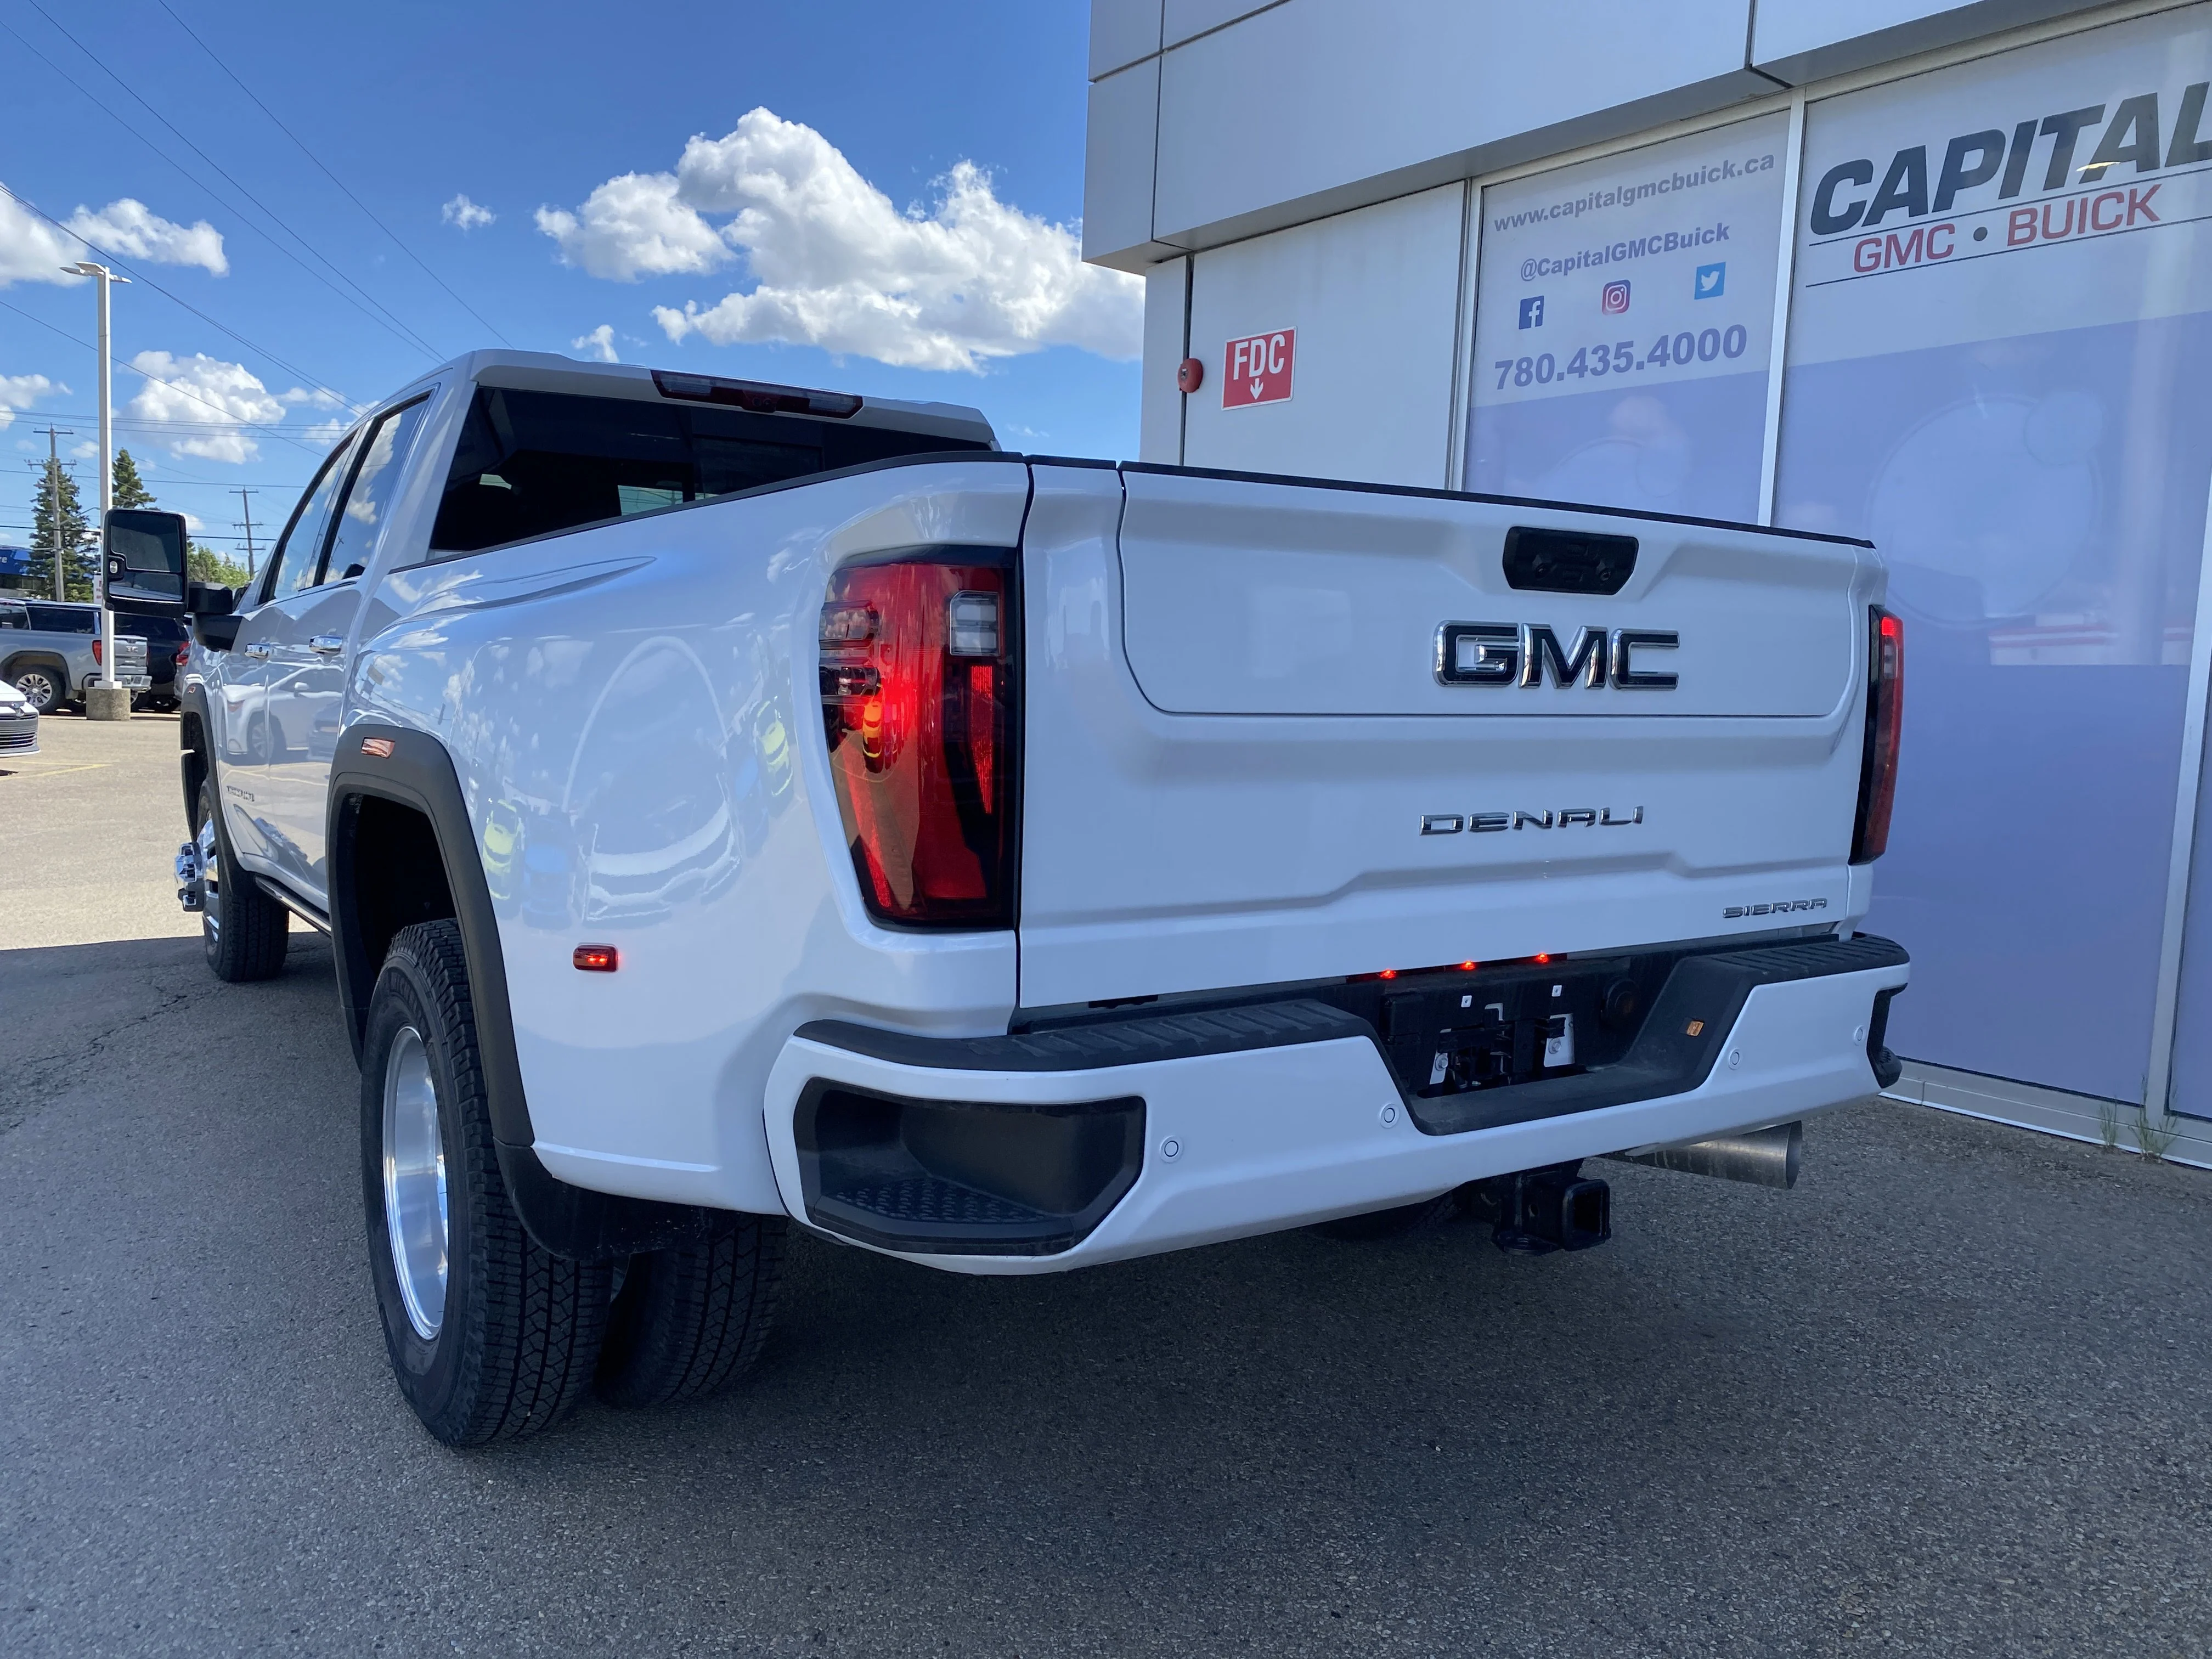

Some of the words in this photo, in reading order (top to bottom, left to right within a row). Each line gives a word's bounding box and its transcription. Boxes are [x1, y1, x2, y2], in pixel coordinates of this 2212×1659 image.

[1810, 81, 2212, 235] CAPITAL
[1494, 154, 1775, 232] www.capitalgmcbuick.ca
[1521, 222, 1730, 281] @CapitalGMCBuick
[1854, 223, 1955, 273] GMC
[2007, 184, 2162, 246] BUICK
[1233, 334, 1285, 380] FDC
[1494, 324, 1747, 390] 780.435.4000
[1433, 620, 1680, 690] GMC
[1419, 805, 1644, 836] DENALI
[1723, 898, 1827, 918] SIERRA
